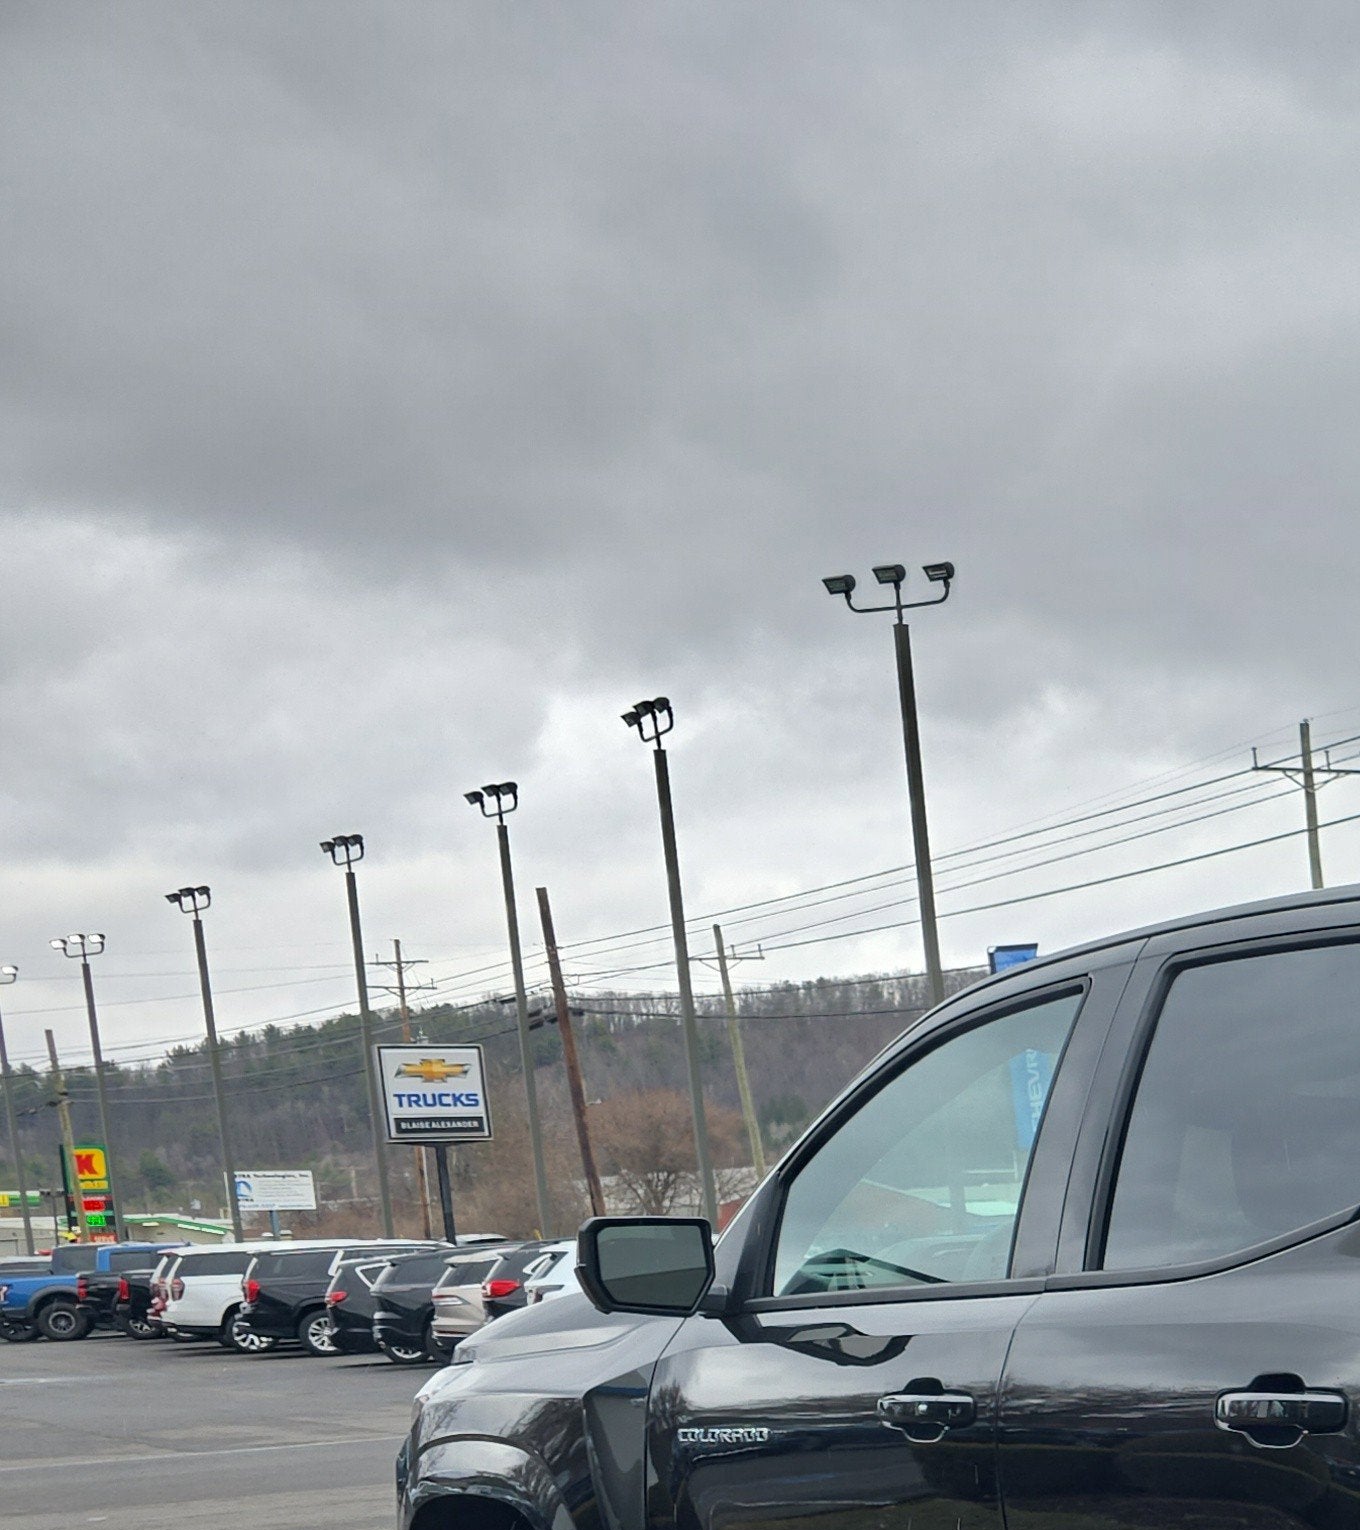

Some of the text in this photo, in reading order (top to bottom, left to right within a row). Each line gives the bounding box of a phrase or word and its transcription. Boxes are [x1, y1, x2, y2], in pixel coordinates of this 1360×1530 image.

[393, 1093, 480, 1108] TRUCKS
[400, 1120, 480, 1130] BLAISE ALEXANDER
[677, 1427, 769, 1443] COLORADO
